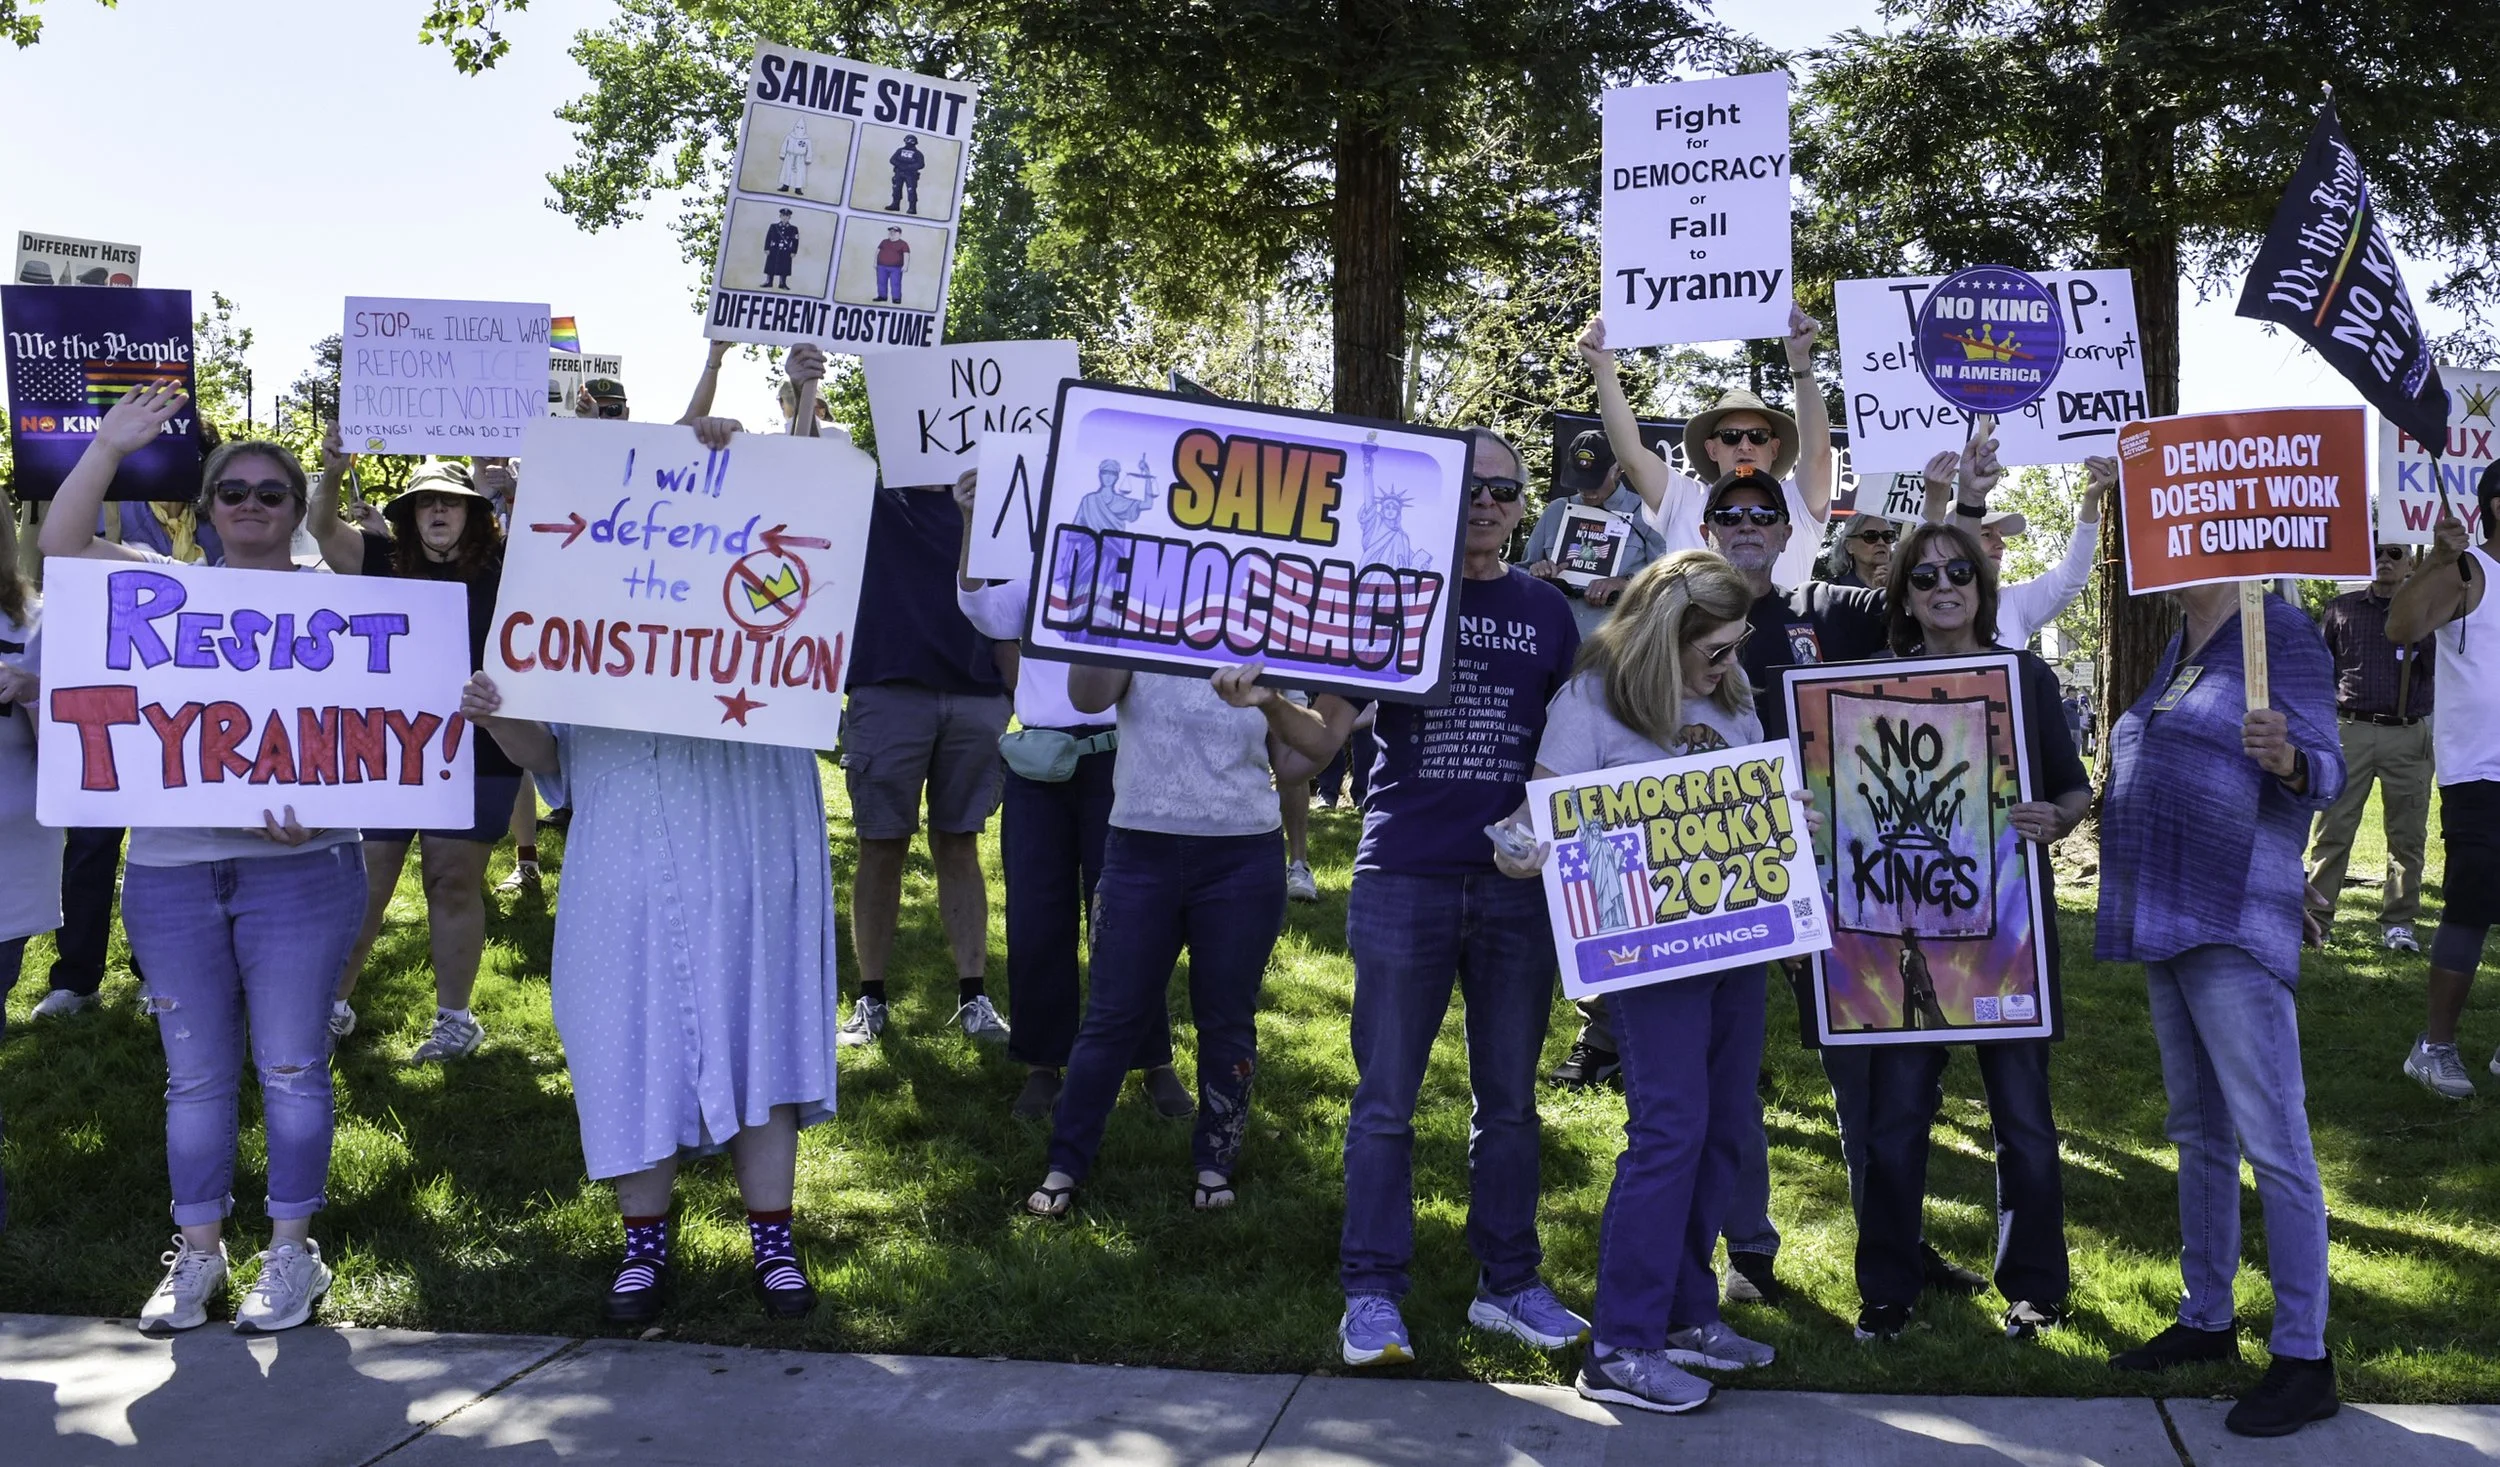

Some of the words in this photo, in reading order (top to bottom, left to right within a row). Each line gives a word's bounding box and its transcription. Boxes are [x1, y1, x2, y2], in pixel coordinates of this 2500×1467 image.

[756, 54, 869, 117] SAME
[873, 78, 968, 136] SHIT
[1656, 103, 1741, 133] Fight
[1686, 137, 1709, 149] for
[1613, 153, 1785, 191] DEMOCRACY
[1690, 194, 1706, 205] or
[1670, 212, 1727, 240] Fall
[2297, 213, 2348, 259] the
[22, 234, 98, 261] DIFFERENT
[102, 245, 136, 265] HATS
[1690, 249, 1706, 260] to
[1615, 267, 1784, 311] Tyranny
[2267, 258, 2329, 313] We
[712, 291, 831, 337] DIFFERENT
[832, 306, 935, 347] COSTUME
[1935, 296, 1975, 321] NO
[1981, 298, 2049, 323] KING
[2331, 285, 2384, 353] NO
[353, 312, 410, 338] STOP
[411, 327, 435, 341] THE
[443, 316, 512, 344] ILLEGAL
[516, 317, 550, 345] WAR
[9, 332, 57, 360] We
[62, 333, 101, 360] the
[103, 331, 190, 369] People
[357, 349, 456, 379] REFORM
[471, 351, 534, 382] ICE
[549, 358, 592, 373] IFFERENT
[594, 357, 618, 375] HATS
[2063, 331, 2136, 370] corrupt
[2370, 330, 2404, 383] IN
[952, 357, 1002, 399] NO
[1935, 364, 1953, 379] IN
[1959, 366, 2041, 383] AMERICA
[353, 384, 449, 419] PROTECT
[452, 386, 546, 421] VOTING
[2057, 390, 2147, 424] DEATH
[20, 416, 57, 432] NO
[62, 416, 102, 433] KIN
[159, 418, 191, 435] AY
[344, 425, 362, 436] NO
[366, 425, 412, 436] KINGS!
[425, 426, 445, 437] WE
[450, 425, 475, 437] CAN
[479, 426, 500, 438] DO
[622, 447, 636, 487] I
[656, 448, 730, 498] will
[2163, 434, 2322, 478] DEMOCRACY
[1168, 428, 1347, 547] SAVE
[2151, 478, 2259, 520] DOESN'T
[2264, 475, 2341, 508] WORK
[590, 497, 762, 555] defend
[2167, 524, 2194, 559] AT
[2200, 516, 2329, 553] GUNPOINT
[622, 559, 691, 602] the
[1571, 559, 1583, 568] NO
[1584, 561, 1598, 570] ICE
[1042, 524, 1445, 676] DEMOCRACY
[106, 570, 410, 674] RESIST
[1507, 621, 1536, 640] UP
[499, 610, 844, 693] CONSTITUTION
[1460, 633, 1537, 655] SCIENCE
[1458, 659, 1472, 668] NOT
[1473, 662, 1489, 671] FLAT
[1459, 672, 1478, 682] WORK
[1454, 696, 1481, 706] CHANGE
[1483, 697, 1491, 705] IS
[1493, 697, 1509, 707] REAL
[1468, 684, 1477, 694] TO
[1479, 685, 1492, 694] THE
[1493, 686, 1515, 696] MOON
[1454, 719, 1467, 729] THE
[1469, 720, 1505, 731] UNIVERSAL
[1459, 707, 1466, 716] IS
[1468, 708, 1506, 719] EXPANDING
[50, 685, 467, 791] TYRANNY!
[1424, 731, 1464, 743] CHEMTRAILS
[1466, 732, 1493, 741] AREN'T
[1461, 744, 1468, 753] IS
[1470, 744, 1476, 753] A
[1478, 745, 1496, 755] FACT
[1873, 715, 1943, 772] NO
[1418, 769, 1446, 779] SCIENCE
[1447, 769, 1455, 779] IS
[1457, 770, 1474, 779] LIKE
[1503, 772, 1515, 782] BUT
[1431, 756, 1446, 766] ARE
[1447, 756, 1460, 766] ALL
[1462, 757, 1483, 767] MADE
[1485, 758, 1496, 768] OF
[1550, 756, 1784, 839] DEMOCRACY
[1646, 795, 1797, 870] ROCKS!
[1650, 846, 1790, 923] 2026
[1850, 838, 1979, 914] KINGS
[1651, 939, 1689, 958] NO
[1694, 923, 1769, 949] KINGS
